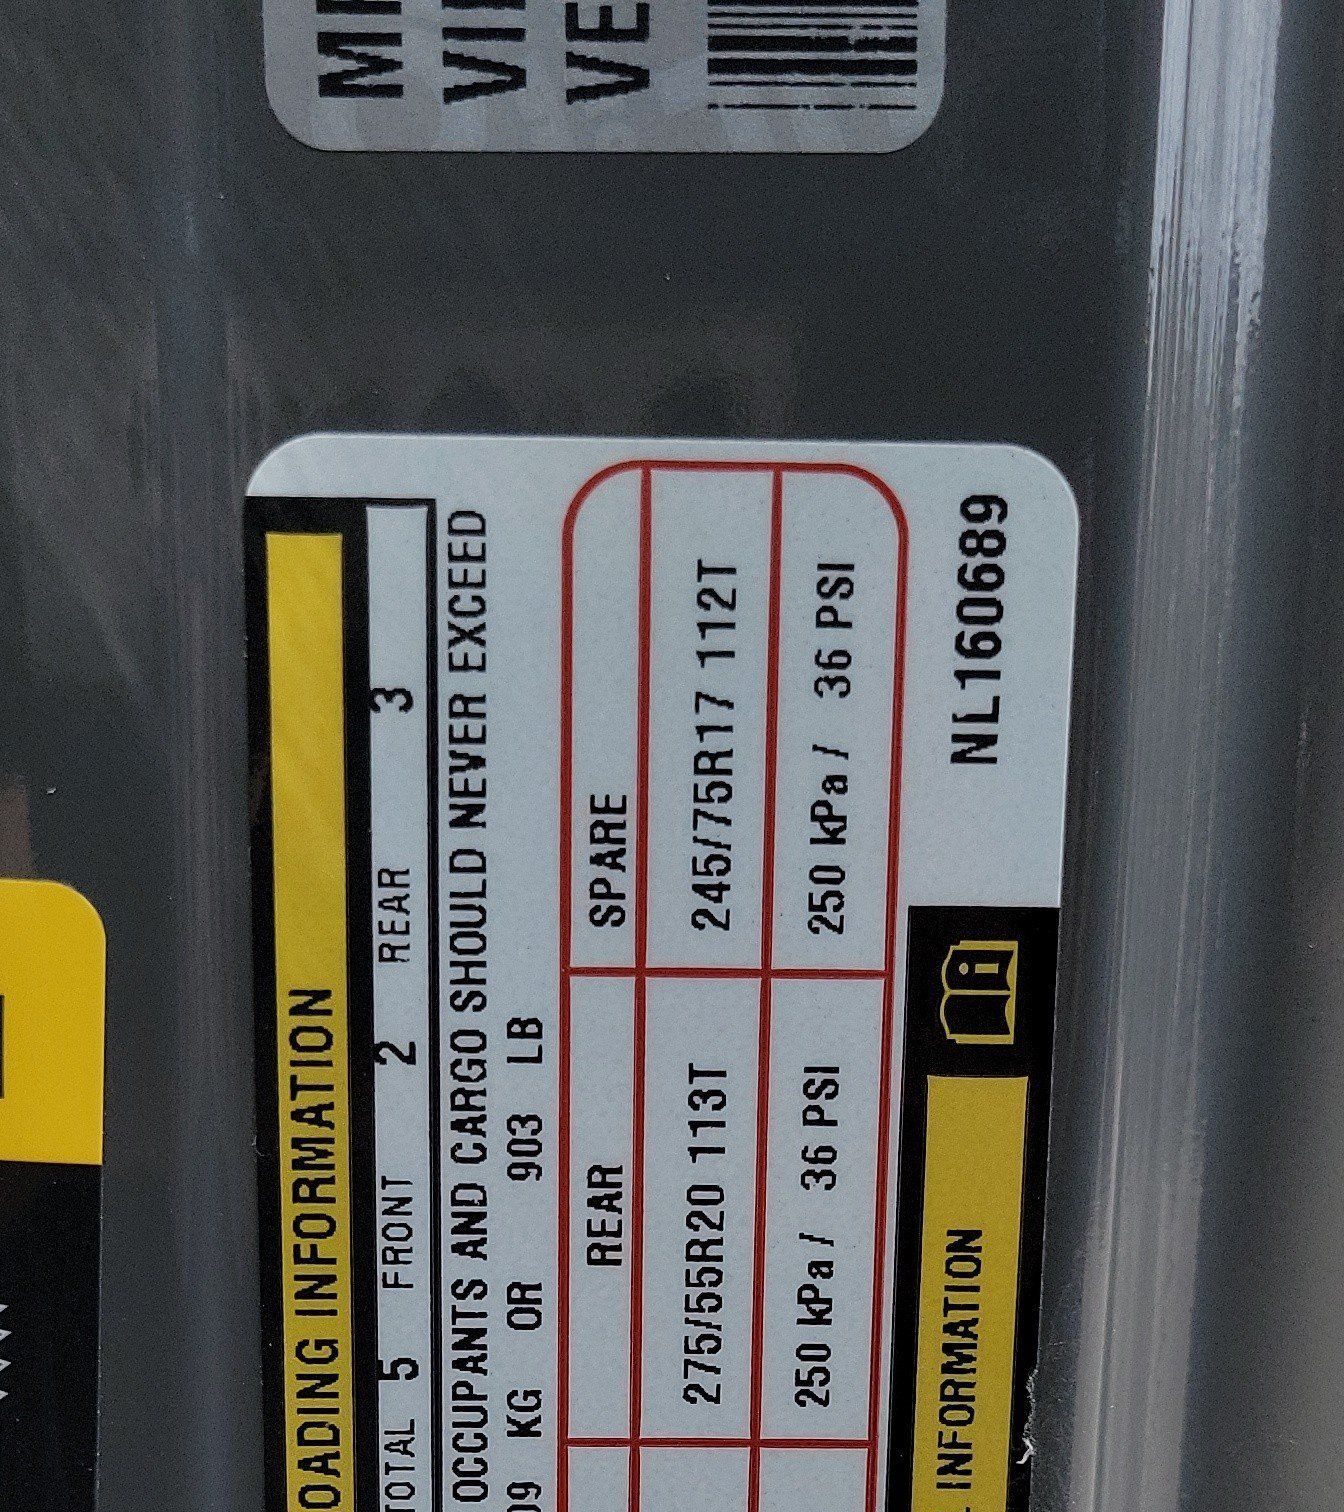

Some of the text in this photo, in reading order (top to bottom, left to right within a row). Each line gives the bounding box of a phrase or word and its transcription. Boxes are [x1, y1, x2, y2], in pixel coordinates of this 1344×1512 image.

[316, 0, 404, 98] M
[442, 0, 527, 105] VI
[448, 511, 486, 672] EXCEED
[816, 564, 854, 628] PSI
[951, 495, 1007, 764] NL160689
[371, 688, 413, 712] 3
[814, 649, 851, 698] 36
[449, 694, 486, 828] NEVER
[692, 559, 736, 930] 245/75R17 112T
[589, 795, 626, 927] SPARE
[808, 865, 845, 934] 250
[378, 868, 410, 962] REAR
[449, 849, 486, 1012] SHOULD
[371, 1039, 416, 1066] 2
[507, 1018, 542, 1063] LB
[450, 1030, 487, 1164] CARGO
[803, 1067, 839, 1126] PSI
[289, 990, 337, 1316] INFORMATION
[507, 1115, 542, 1180] 903
[801, 1146, 837, 1190] 36
[381, 1176, 413, 1288] FRONT
[451, 1183, 487, 1260] AND
[587, 1165, 622, 1266] REAR
[683, 1063, 726, 1404] 275/55R20 113T
[507, 1282, 542, 1330] OR
[378, 1358, 418, 1381] 5
[451, 1279, 488, 1502] OCCUPANTS
[795, 1344, 831, 1407] 250
[937, 1230, 982, 1489] INFORMATION
[507, 1390, 541, 1437] KG
